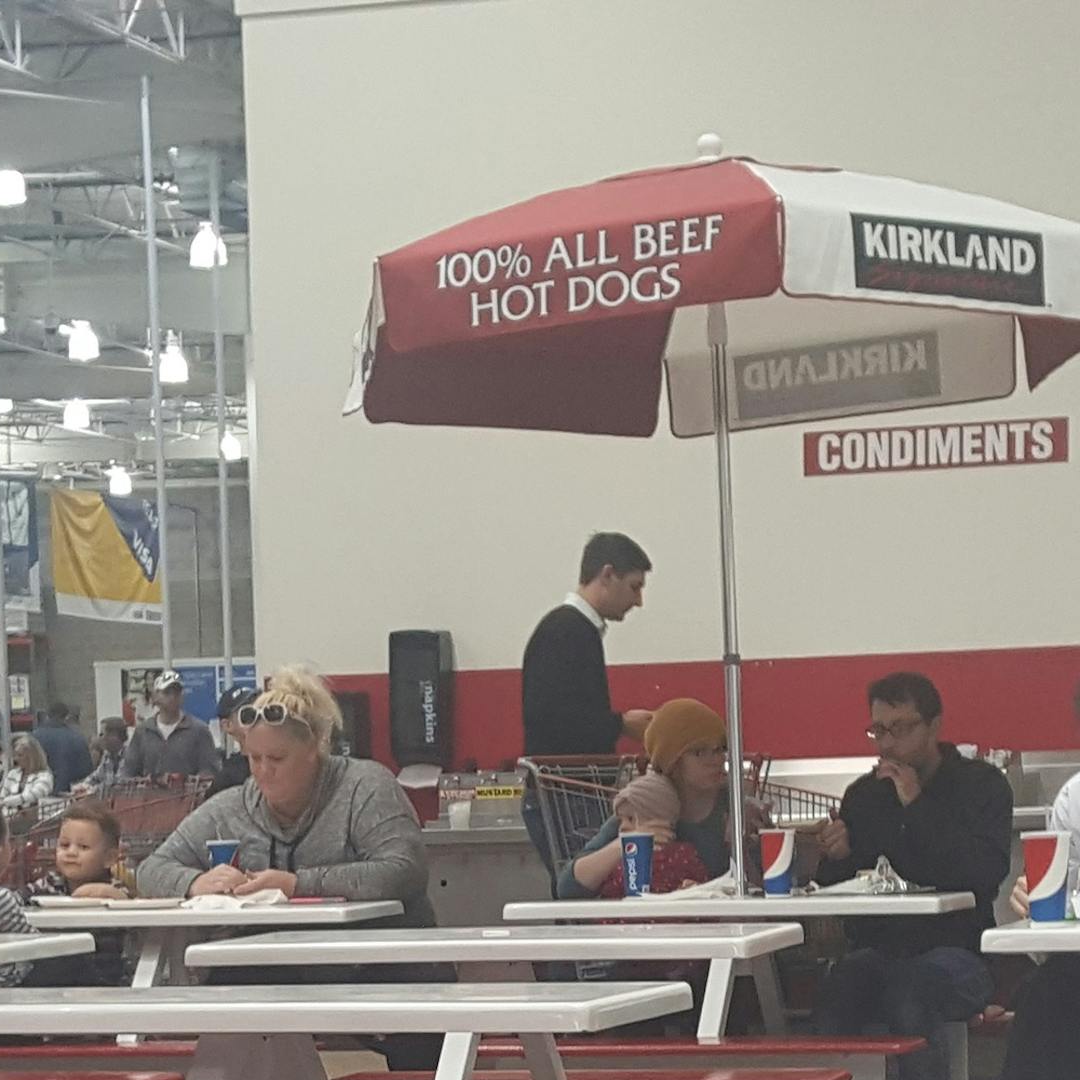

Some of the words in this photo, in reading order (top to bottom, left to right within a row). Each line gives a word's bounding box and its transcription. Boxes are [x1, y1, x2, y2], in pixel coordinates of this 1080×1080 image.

[435, 242, 532, 290] 100%
[543, 229, 619, 273] ALL
[633, 214, 723, 261] BEEF
[862, 221, 1037, 276] KIRKLAND
[470, 279, 555, 327] HOT
[567, 262, 681, 312] DOGS
[817, 420, 1055, 472] CONDIMENTS
[133, 528, 154, 576] VISA
[422, 684, 437, 743] napkins
